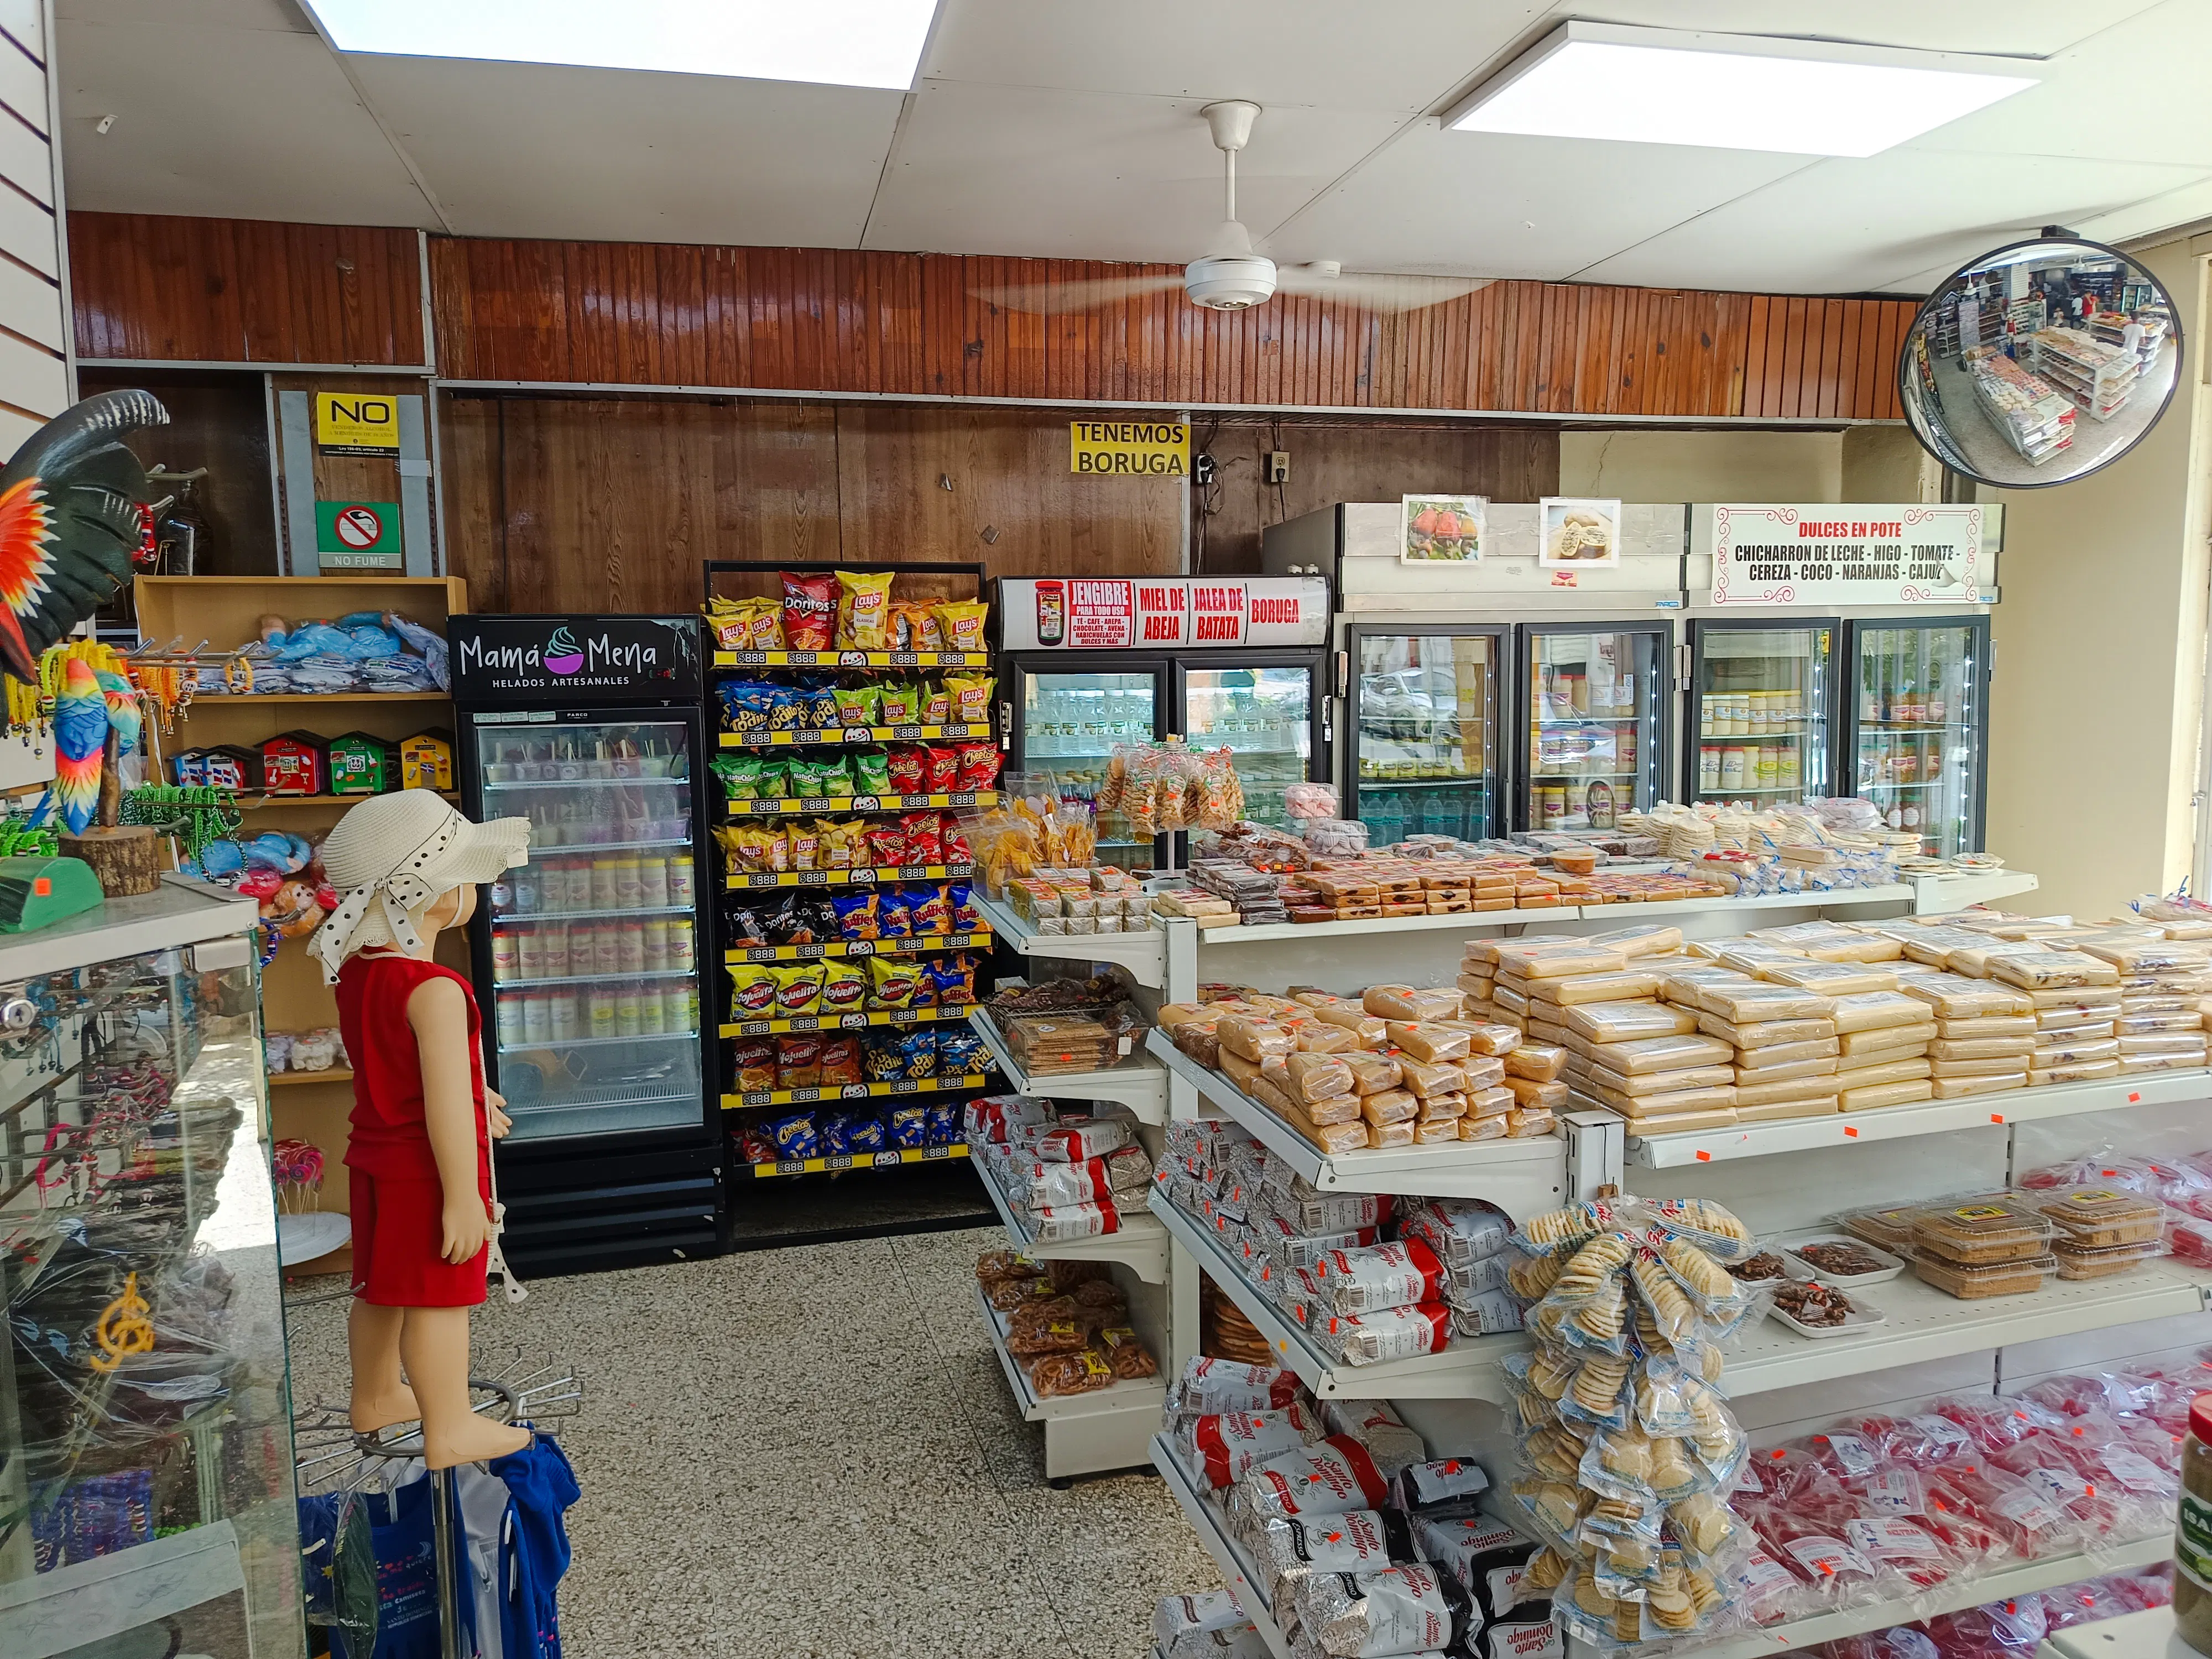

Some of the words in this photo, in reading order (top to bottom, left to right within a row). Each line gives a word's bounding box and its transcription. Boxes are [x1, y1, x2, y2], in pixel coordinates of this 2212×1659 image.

[332, 400, 389, 424] NO
[1077, 423, 1183, 444] TENEMOS
[1079, 452, 1183, 474] BORUGA
[1799, 522, 1848, 538] DULCES
[1851, 523, 1866, 538] EN
[1870, 522, 1902, 538] POTE
[1735, 545, 1811, 562] CHICHARRON
[1815, 545, 1828, 561] DE
[1831, 545, 1864, 561] LECHE
[1874, 545, 1901, 561] HIGO
[1911, 545, 1954, 561] TOMATE
[335, 556, 351, 566] NO
[354, 556, 386, 566] FUME
[1749, 565, 1791, 581] CEREZA
[1801, 564, 1833, 580] COCO
[1843, 564, 1899, 580] NARANJAS
[854, 592, 880, 609] Lay's
[1072, 582, 1129, 606] JENGIBRE
[1140, 588, 1167, 612] MIEL
[1171, 588, 1185, 611] DE
[1193, 588, 1226, 612] JALEA
[1230, 588, 1244, 611] DE
[785, 597, 830, 612] Doritos
[1076, 606, 1093, 615] PARA
[1094, 606, 1111, 615] TODO
[1112, 606, 1125, 615] USO
[1251, 598, 1299, 624] BORUGA
[721, 623, 744, 640] Lay's
[752, 616, 772, 635] Lay's
[921, 617, 937, 634] Lay's
[955, 618, 978, 634] Lay's
[1144, 616, 1179, 640] ABEJA
[1196, 616, 1239, 640] BATATA
[460, 635, 539, 676] Mamá
[588, 633, 656, 674] Mena
[737, 653, 765, 664] $888
[788, 653, 816, 664] $888
[890, 654, 917, 665] $888
[938, 654, 964, 665] $888
[493, 679, 545, 688] HELADOS
[552, 676, 629, 687] ARTESANALES
[961, 688, 983, 703] Lay's
[842, 707, 862, 719] Lay's
[885, 703, 904, 716] Lay's
[793, 731, 820, 742] $888
[894, 727, 921, 738] $888
[941, 724, 967, 736] $888
[743, 733, 770, 744] $888
[963, 748, 997, 768] Cheetos
[819, 766, 844, 776] atuChips
[727, 774, 755, 782] NatuChips
[752, 801, 779, 811] $888
[802, 800, 828, 810] $888
[902, 796, 928, 806] $888
[949, 795, 974, 805] $888
[796, 838, 818, 852] Lay's
[799, 873, 826, 883] $888
[899, 868, 925, 878] $888
[749, 875, 776, 885] $888
[898, 940, 923, 950] $888
[943, 936, 969, 947] $888
[748, 949, 775, 960] $888
[797, 946, 824, 957] $888
[890, 1010, 916, 1021] $888
[937, 1006, 963, 1018] $888
[742, 1023, 769, 1034] $888
[790, 1019, 818, 1030] $888
[822, 1049, 848, 1064] ojuelitas
[891, 1081, 917, 1093] $888
[937, 1077, 963, 1088] $888
[792, 1090, 818, 1101] $888
[777, 1118, 811, 1145] Cheetos
[923, 1147, 948, 1159] $888
[777, 1162, 805, 1173] $888
[1307, 1458, 1348, 1500] Domingo
[1325, 1461, 1354, 1490] Santo
[1270, 1473, 1292, 1509] MOLIDO
[1291, 1522, 1305, 1556] ESPRESSO
[1342, 1512, 1369, 1559] Domingo
[1357, 1521, 1381, 1551] Santo
[1460, 1529, 1516, 1547] Domingo
[1474, 1537, 1510, 1550] Santo
[1410, 1564, 1433, 1592] Santo
[1424, 1610, 1435, 1647] Domingo
[1432, 1618, 1442, 1643] Santo
[1507, 1623, 1553, 1645] Domingo
[1515, 1637, 1545, 1655] Santo
